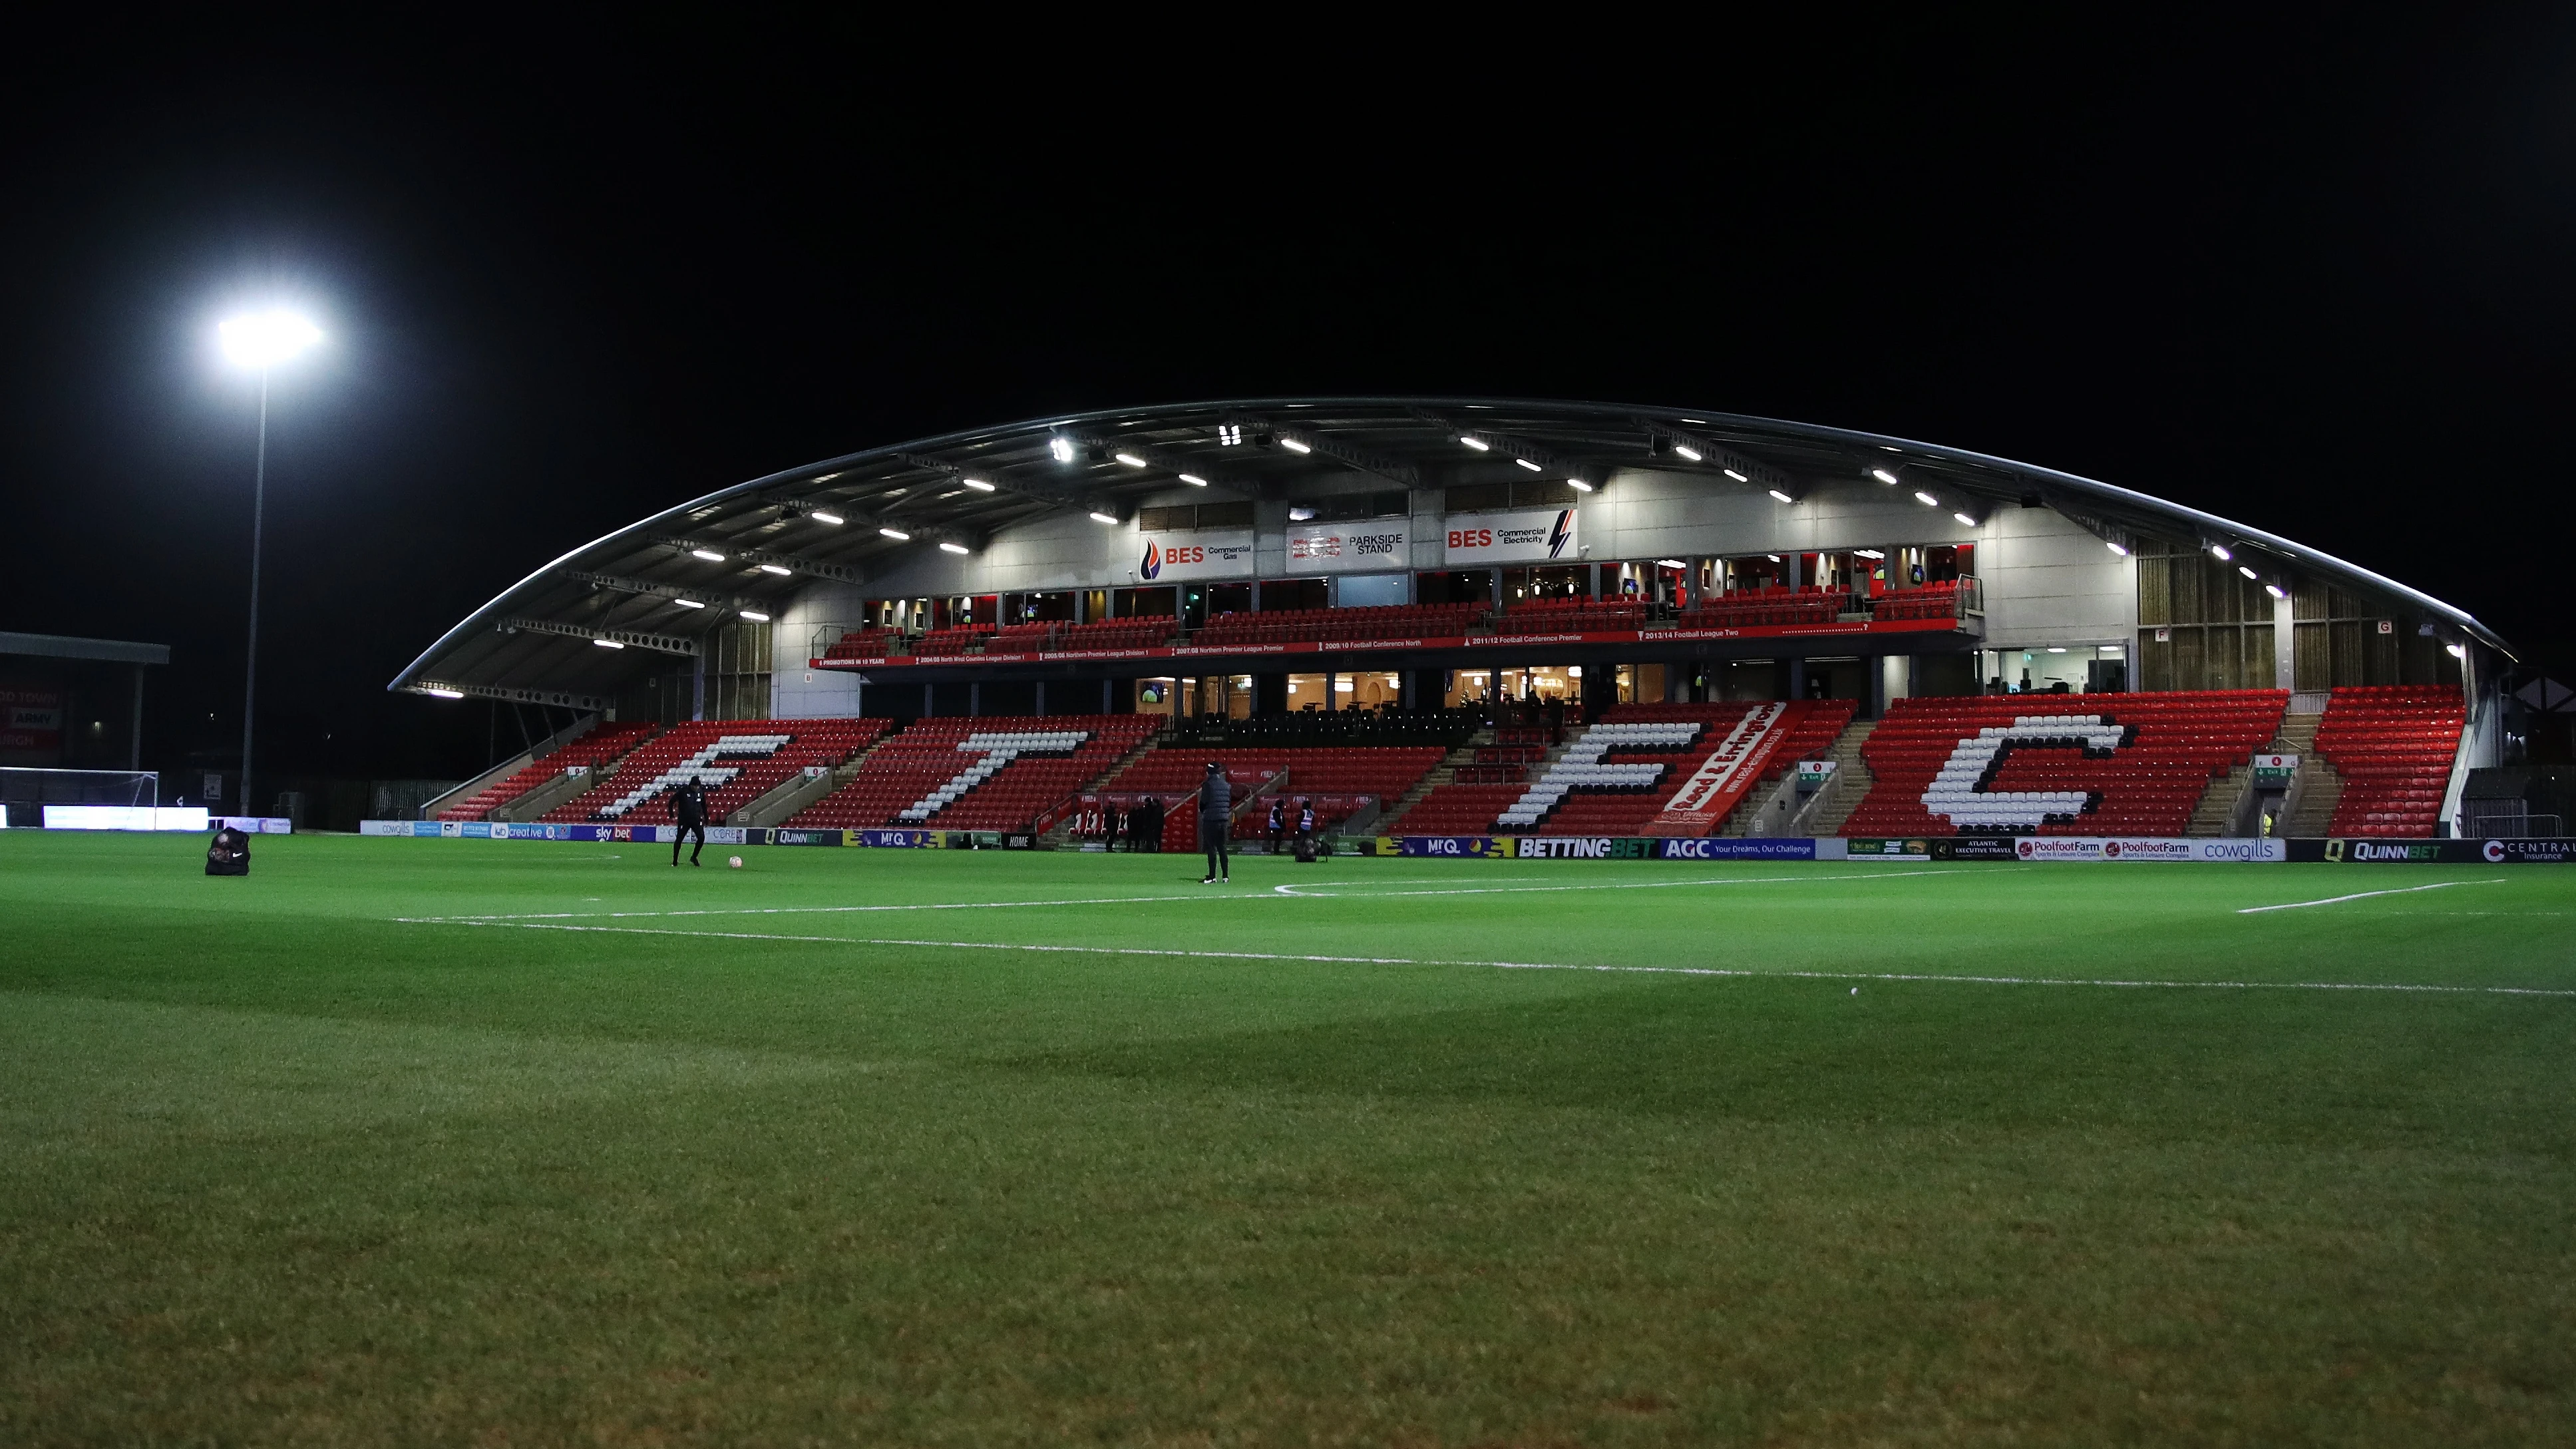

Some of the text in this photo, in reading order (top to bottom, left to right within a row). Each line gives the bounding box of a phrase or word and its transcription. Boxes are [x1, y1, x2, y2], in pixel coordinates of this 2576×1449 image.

[1497, 526, 1546, 536] Commercial
[1349, 534, 1403, 546] PARKSIDE
[1449, 529, 1492, 547] BES
[1503, 535, 1543, 544] Electricity
[1208, 544, 1250, 553] Commercial
[1358, 544, 1393, 554] STAND
[1166, 546, 1204, 564] BES
[2381, 622, 2389, 631] G
[19, 692, 57, 704] TOWN
[15, 712, 52, 724] ARMY
[1671, 778, 1718, 809] Read
[1705, 765, 1730, 775] &
[509, 827, 542, 837] creative
[596, 826, 631, 839] sky bet
[780, 831, 824, 844] QUINNBET
[881, 832, 906, 845] MrQ
[1010, 836, 1029, 847] HOME
[1428, 839, 1461, 854] MrQ
[1666, 840, 1710, 858] AGC
[1732, 845, 1761, 853] Dreams,
[1776, 845, 1811, 855] Challenge
[2034, 841, 2100, 852] PoolfootFarm
[2122, 842, 2189, 853] PoolfootFarm
[2205, 839, 2273, 861] cowgills
[2354, 842, 2442, 860] QUINNBET
[2507, 843, 2576, 853] CENTRAL
